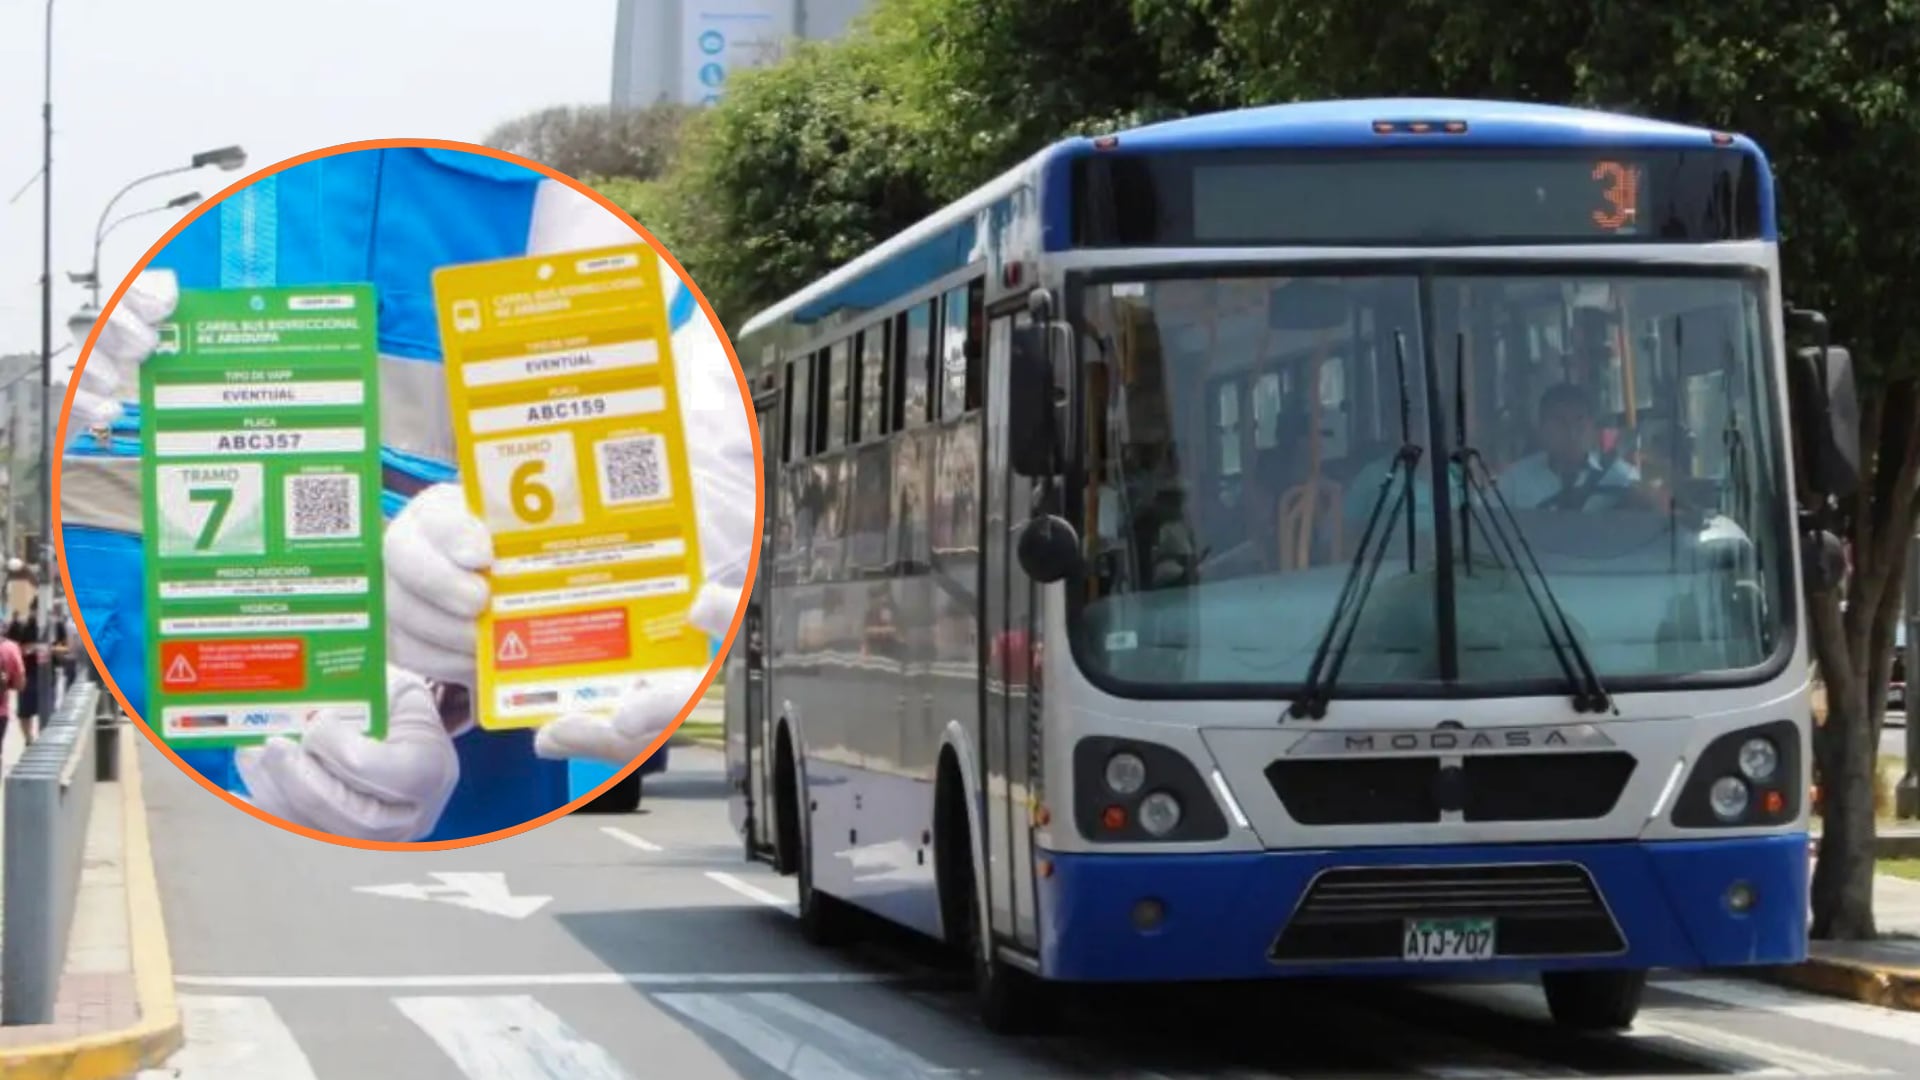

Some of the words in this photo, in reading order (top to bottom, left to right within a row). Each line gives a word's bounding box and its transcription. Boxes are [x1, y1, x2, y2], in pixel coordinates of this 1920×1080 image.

[525, 351, 594, 373] EVENTUAL
[223, 389, 295, 401] EVENTUAL
[527, 398, 606, 421] ABC159
[243, 417, 277, 428] PLACA
[218, 434, 302, 450] ABC357
[496, 439, 552, 457] TRAMO
[182, 468, 240, 483] TRAMO
[510, 460, 554, 523] 6
[189, 488, 234, 551] 7
[1344, 730, 1569, 751] MODASA
[1406, 929, 1490, 957] ATJ-707
